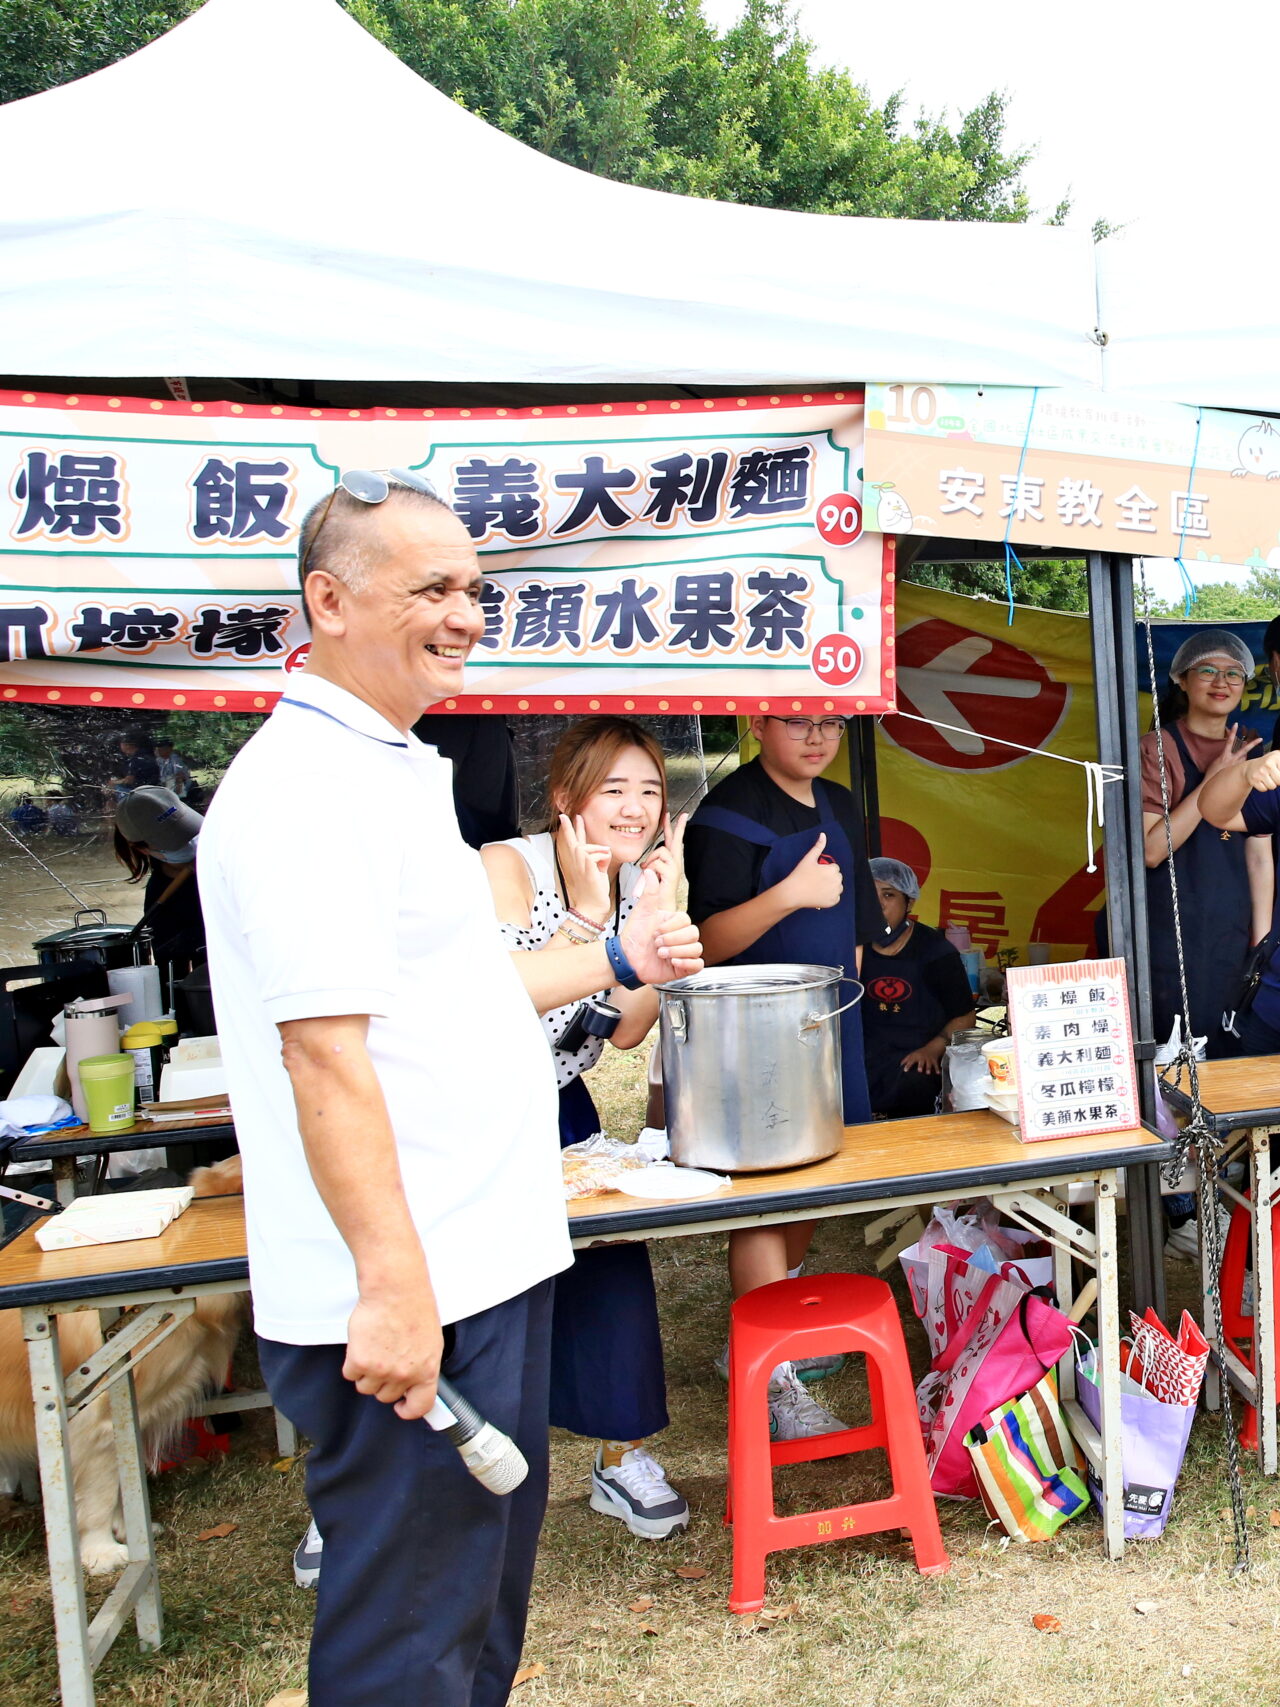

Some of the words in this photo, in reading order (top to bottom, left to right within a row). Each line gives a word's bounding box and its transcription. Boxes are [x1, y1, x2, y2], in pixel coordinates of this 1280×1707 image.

[887, 384, 937, 427] 10
[453, 445, 811, 538] 義大利麵
[938, 466, 1211, 539] 安東教全區
[820, 504, 859, 534] 90
[817, 646, 857, 674] 50
[1031, 988, 1106, 1008] 素燥飯
[1034, 1019, 1109, 1041] 素肉燥
[1037, 1046, 1112, 1068] 義大利麵
[1040, 1076, 1115, 1099] 冬瓜檸檬
[1042, 1104, 1118, 1127] 美顏水果茶
